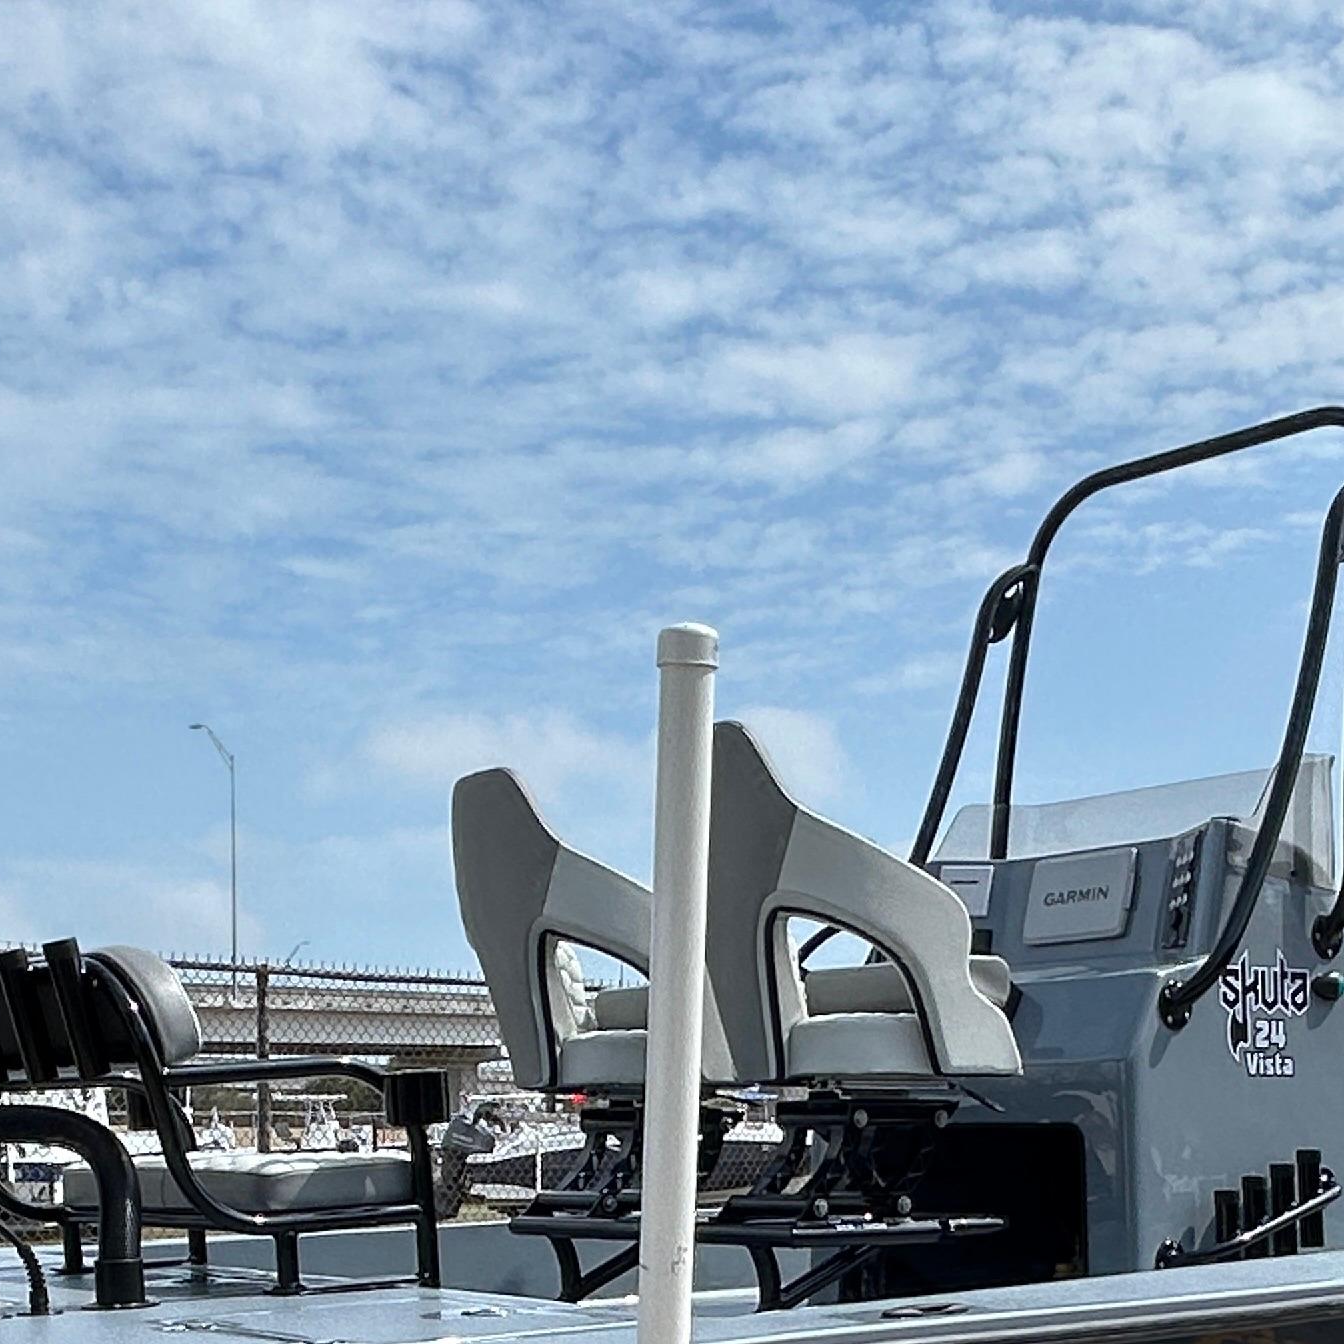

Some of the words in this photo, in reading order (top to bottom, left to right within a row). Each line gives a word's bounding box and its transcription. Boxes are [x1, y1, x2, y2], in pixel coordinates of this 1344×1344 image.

[1043, 885, 1110, 907] GARMIN
[1255, 1019, 1287, 1049] 24
[1244, 1051, 1295, 1077] Vista
